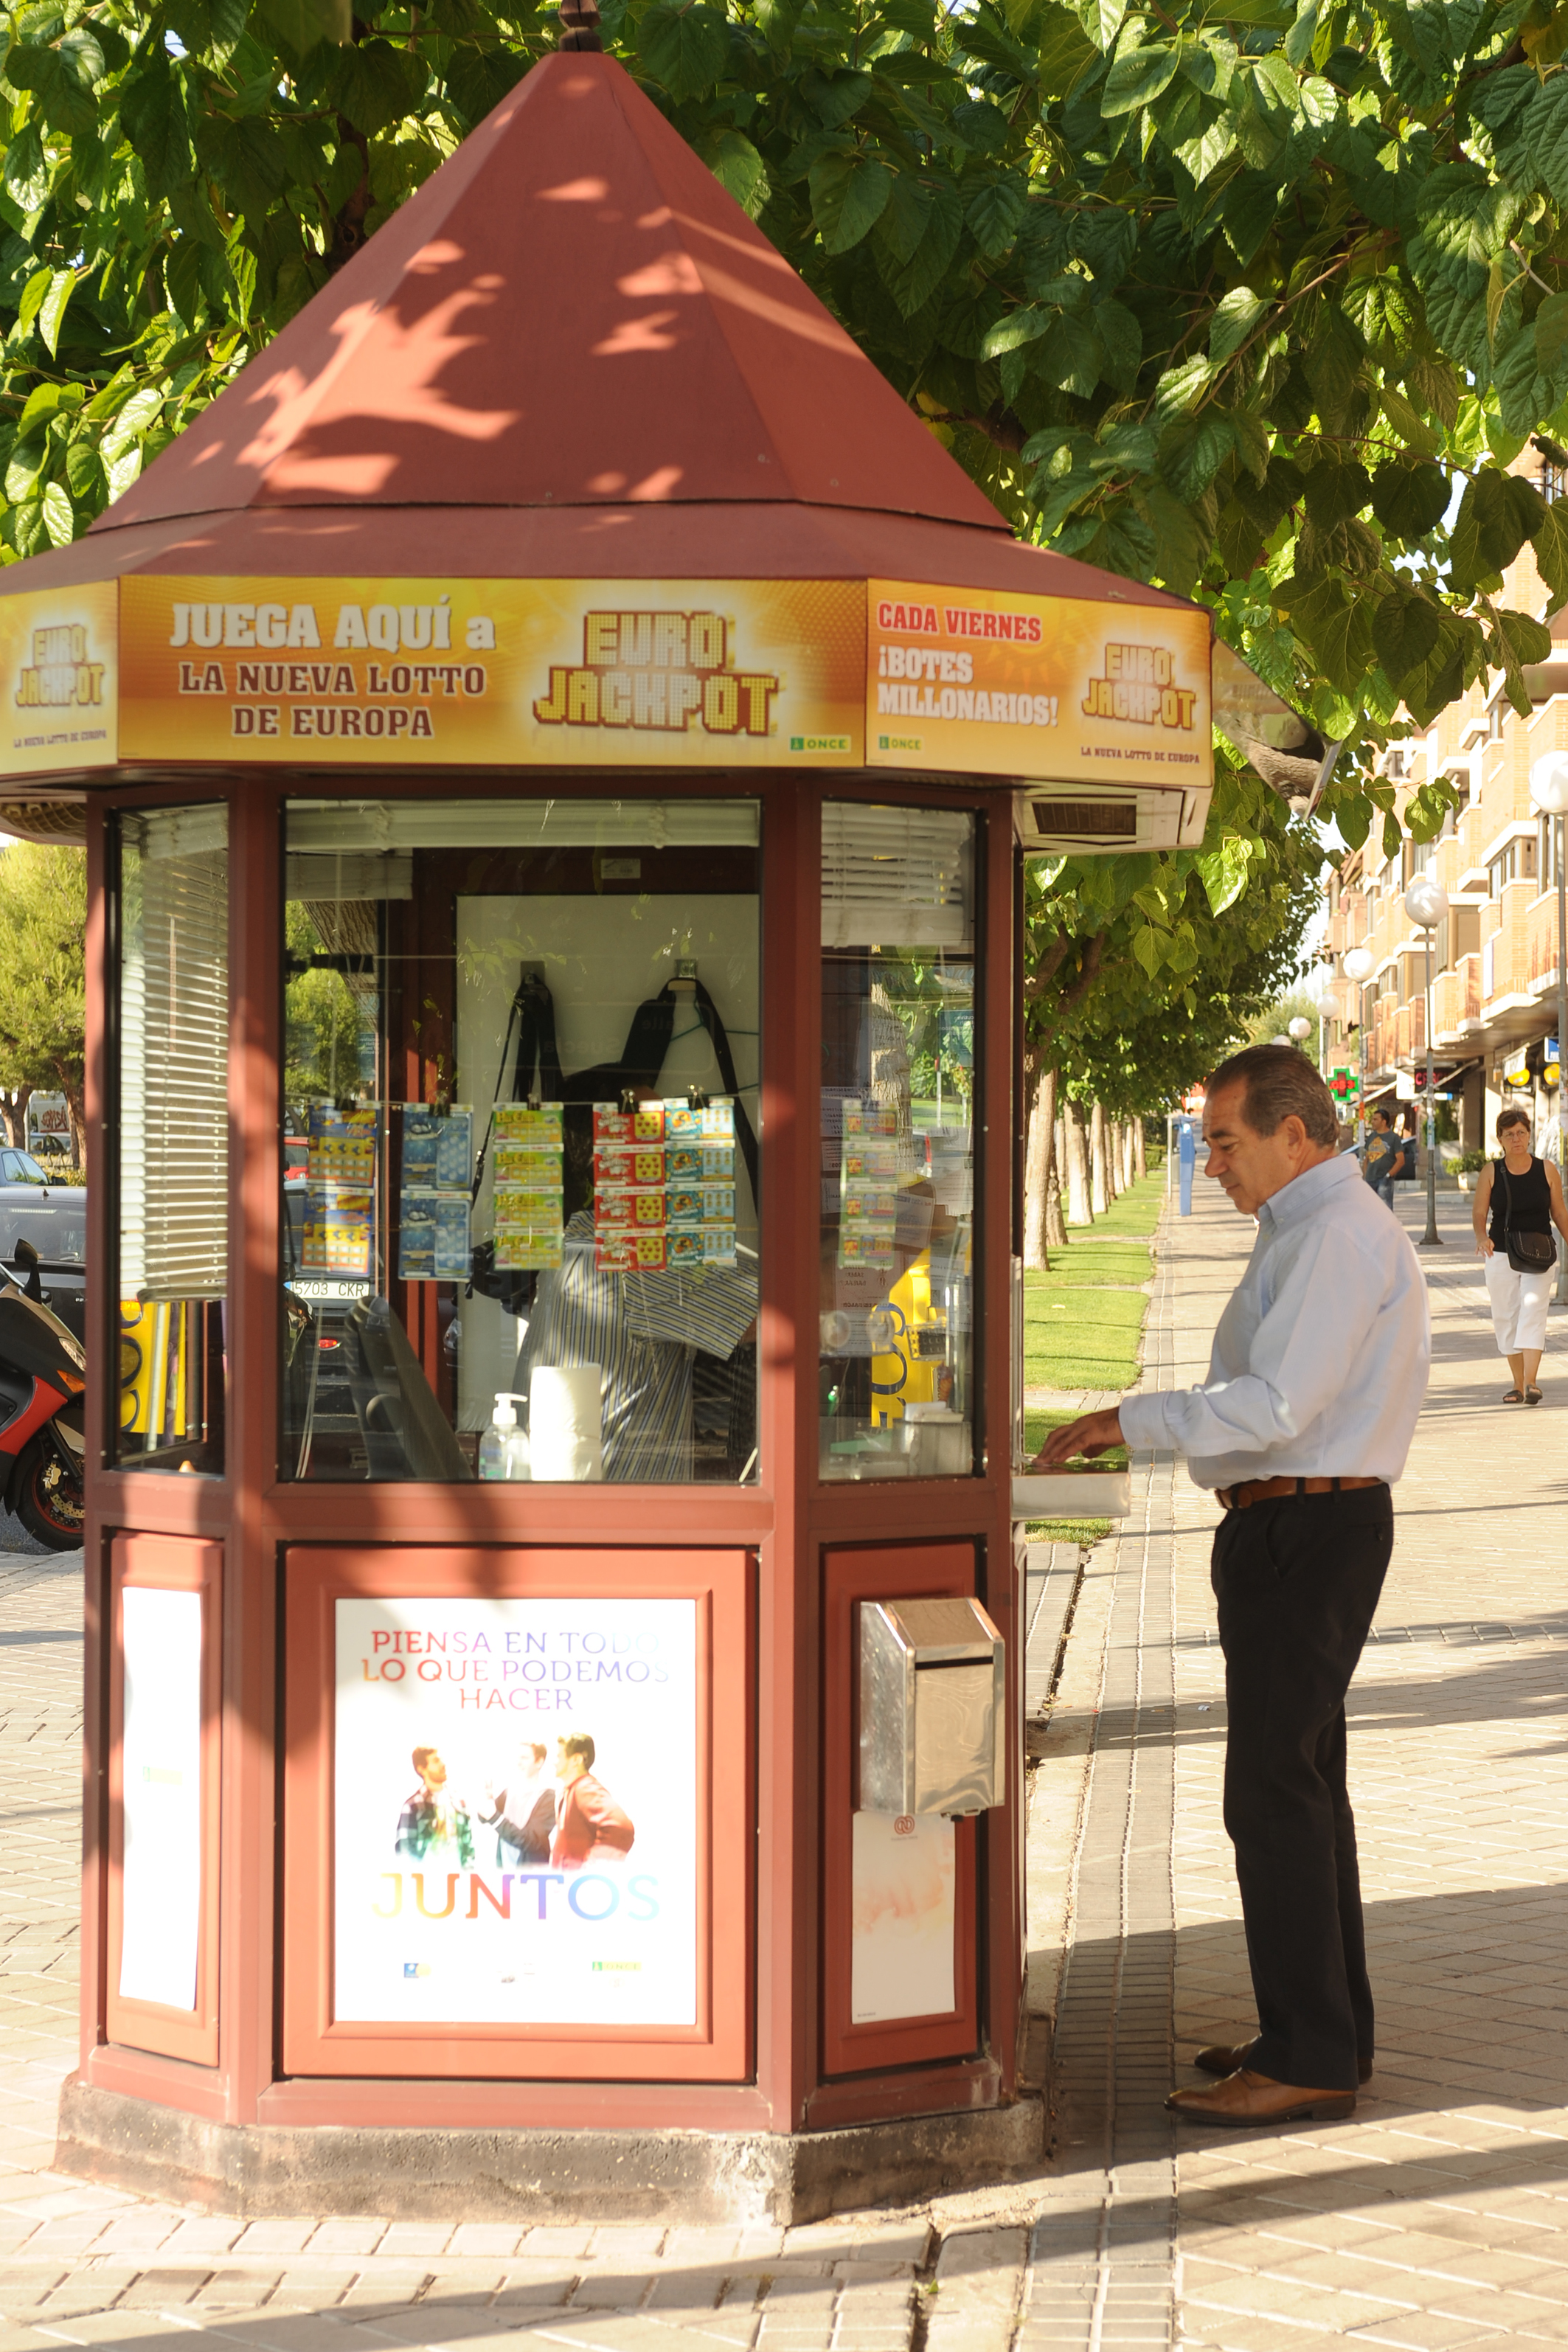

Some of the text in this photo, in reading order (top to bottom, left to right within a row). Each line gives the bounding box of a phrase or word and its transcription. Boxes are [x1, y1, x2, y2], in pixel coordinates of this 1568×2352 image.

[170, 594, 495, 653] JUEGA AQUÍ a
[584, 611, 727, 670] EURO
[878, 603, 1041, 642] CADA VIERNES
[33, 623, 87, 667] EURO
[878, 645, 974, 684] ¡BOTES
[1106, 642, 1173, 685] EURO
[16, 664, 105, 706] JACKPOT
[178, 663, 486, 695] LA NUEVA LOTTO
[533, 667, 780, 736] JACKPOT
[878, 683, 1058, 727] MILLONARIOS!
[1082, 679, 1196, 730] JACKPOT
[232, 706, 434, 738] DE EUROPA
[807, 738, 847, 750] ONCE
[891, 738, 921, 750] ONCE
[1081, 746, 1200, 763] LA NUEVA LOTTO DE EUROPA
[295, 1281, 364, 1297] 5703 CKR
[371, 1631, 659, 1654] PIENSA EN TODO
[361, 1659, 669, 1682] LO QUE PODEMOS
[459, 1687, 573, 1710] HACER
[371, 1873, 660, 1921] JUNTOS
